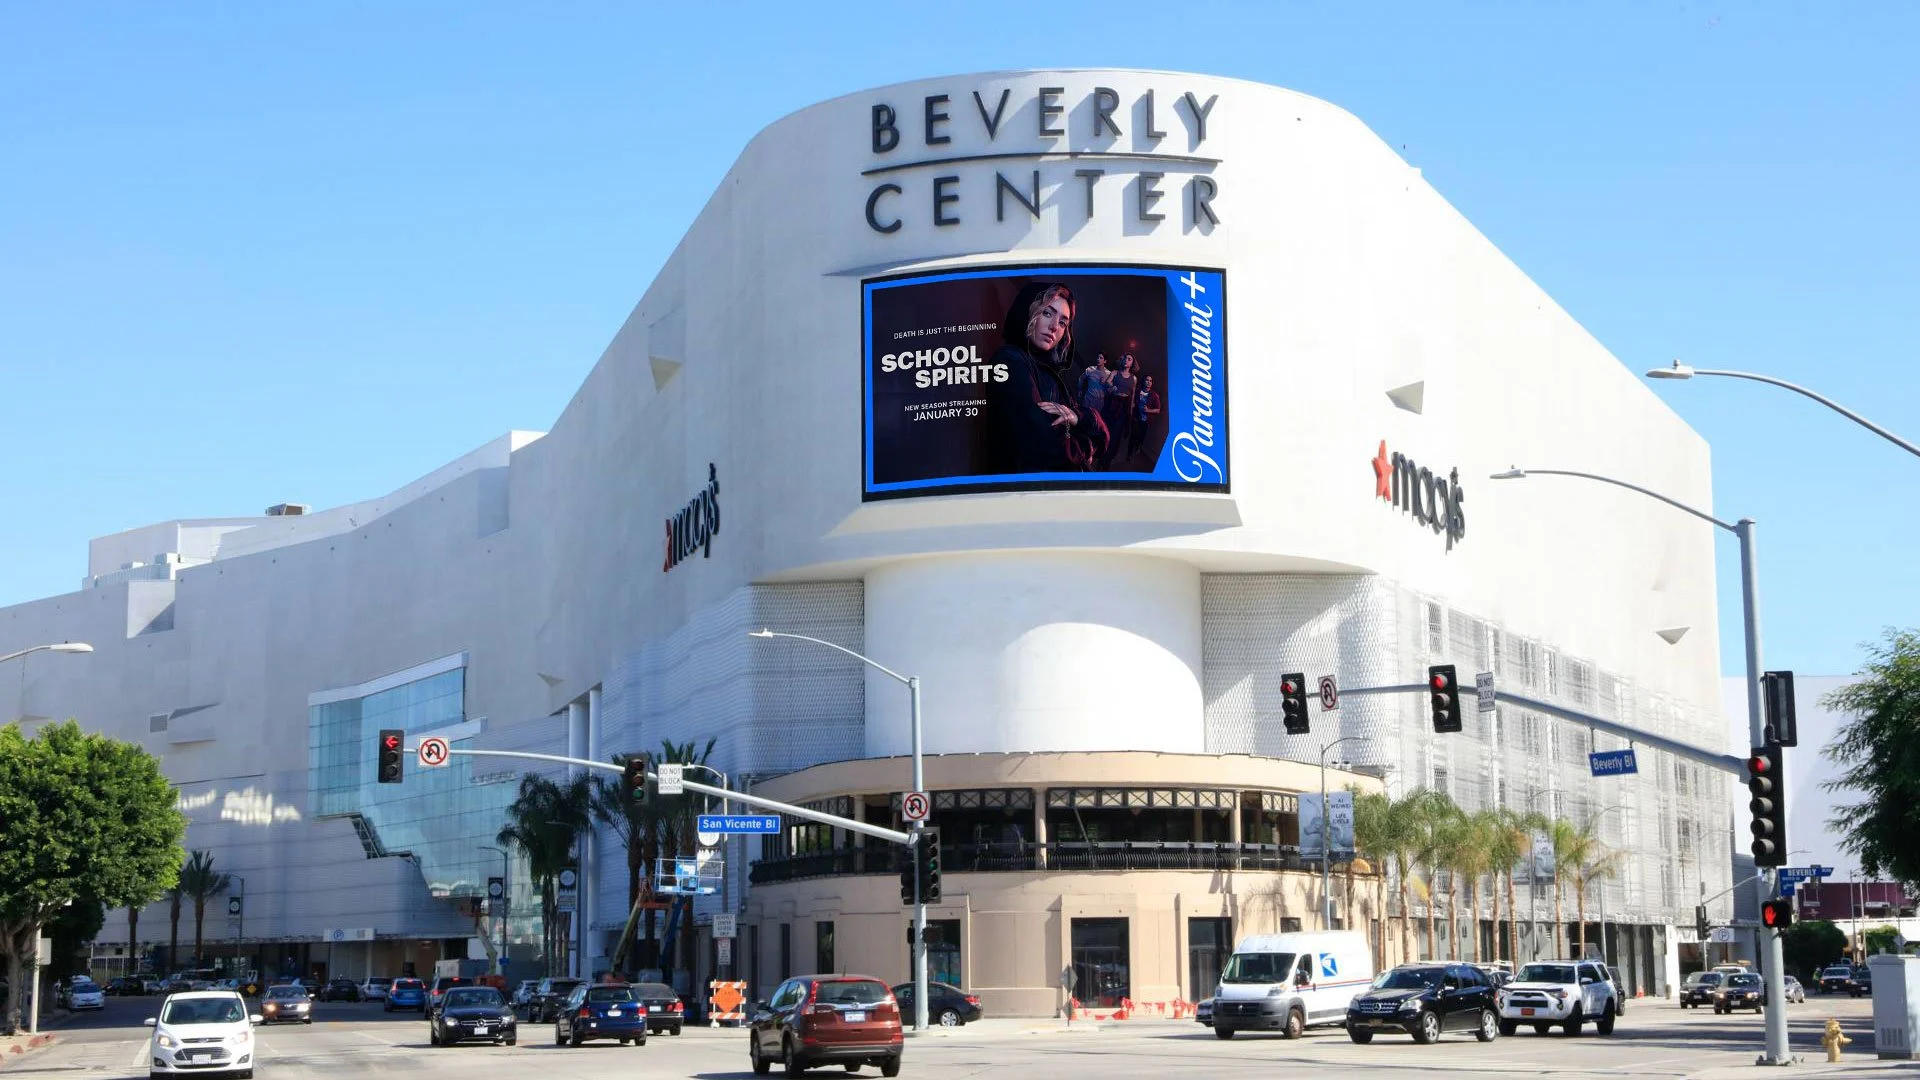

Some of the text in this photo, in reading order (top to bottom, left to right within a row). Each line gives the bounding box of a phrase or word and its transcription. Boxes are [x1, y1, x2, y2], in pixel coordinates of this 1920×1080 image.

[872, 87, 1219, 153] BEVERLY
[865, 169, 1221, 234] CENTER
[893, 330, 916, 339] DEATH
[926, 327, 942, 335] JUST
[944, 325, 957, 333] THE
[958, 323, 997, 332] BEGINNING
[881, 345, 982, 373] SCHOOL
[915, 363, 1009, 388] SPIRITS
[1172, 271, 1222, 484] Paramount+
[904, 399, 987, 412] NEW SEASON STREAMING
[913, 407, 979, 421] JANUARY 30
[1592, 756, 1623, 772] Beverly
[703, 819, 776, 829] San Vicente Bl
